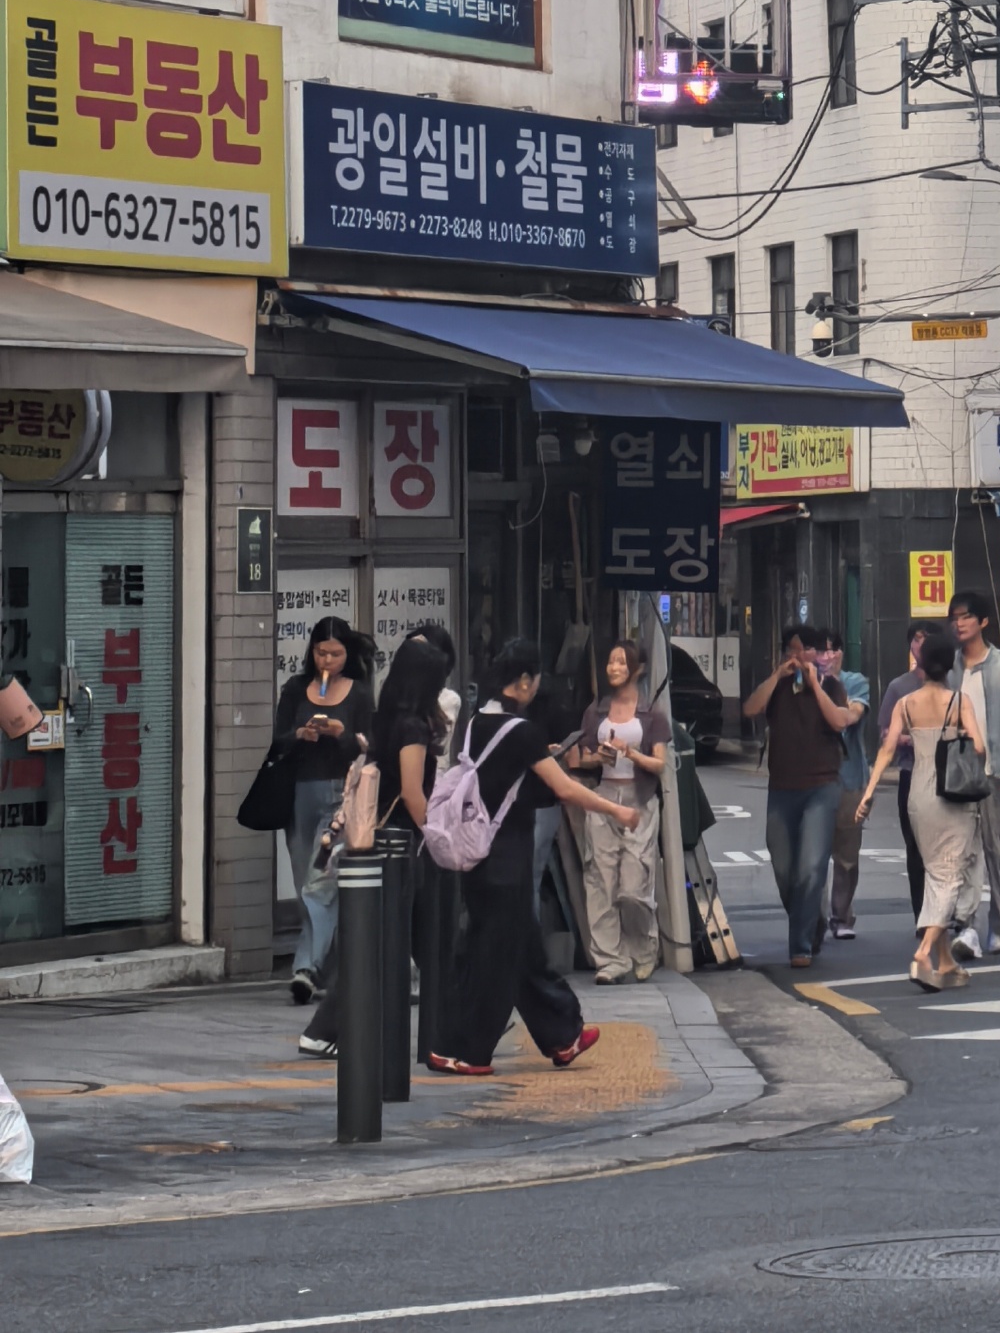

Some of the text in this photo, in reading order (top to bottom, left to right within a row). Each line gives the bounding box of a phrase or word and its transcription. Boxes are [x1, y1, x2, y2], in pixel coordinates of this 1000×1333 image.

[26, 16, 59, 148] 골든
[75, 30, 268, 166] 부동산
[328, 107, 588, 214] 광일설비 철물
[32, 185, 261, 250] 010-6327-5815
[330, 205, 407, 232] T.2279-9673
[419, 214, 483, 240] 2273-8248
[610, 430, 711, 490] 열쇠
[250, 563, 261, 580] 18
[605, 524, 716, 584] 도장
[918, 554, 946, 603] 임대
[101, 628, 142, 874] 부동산
